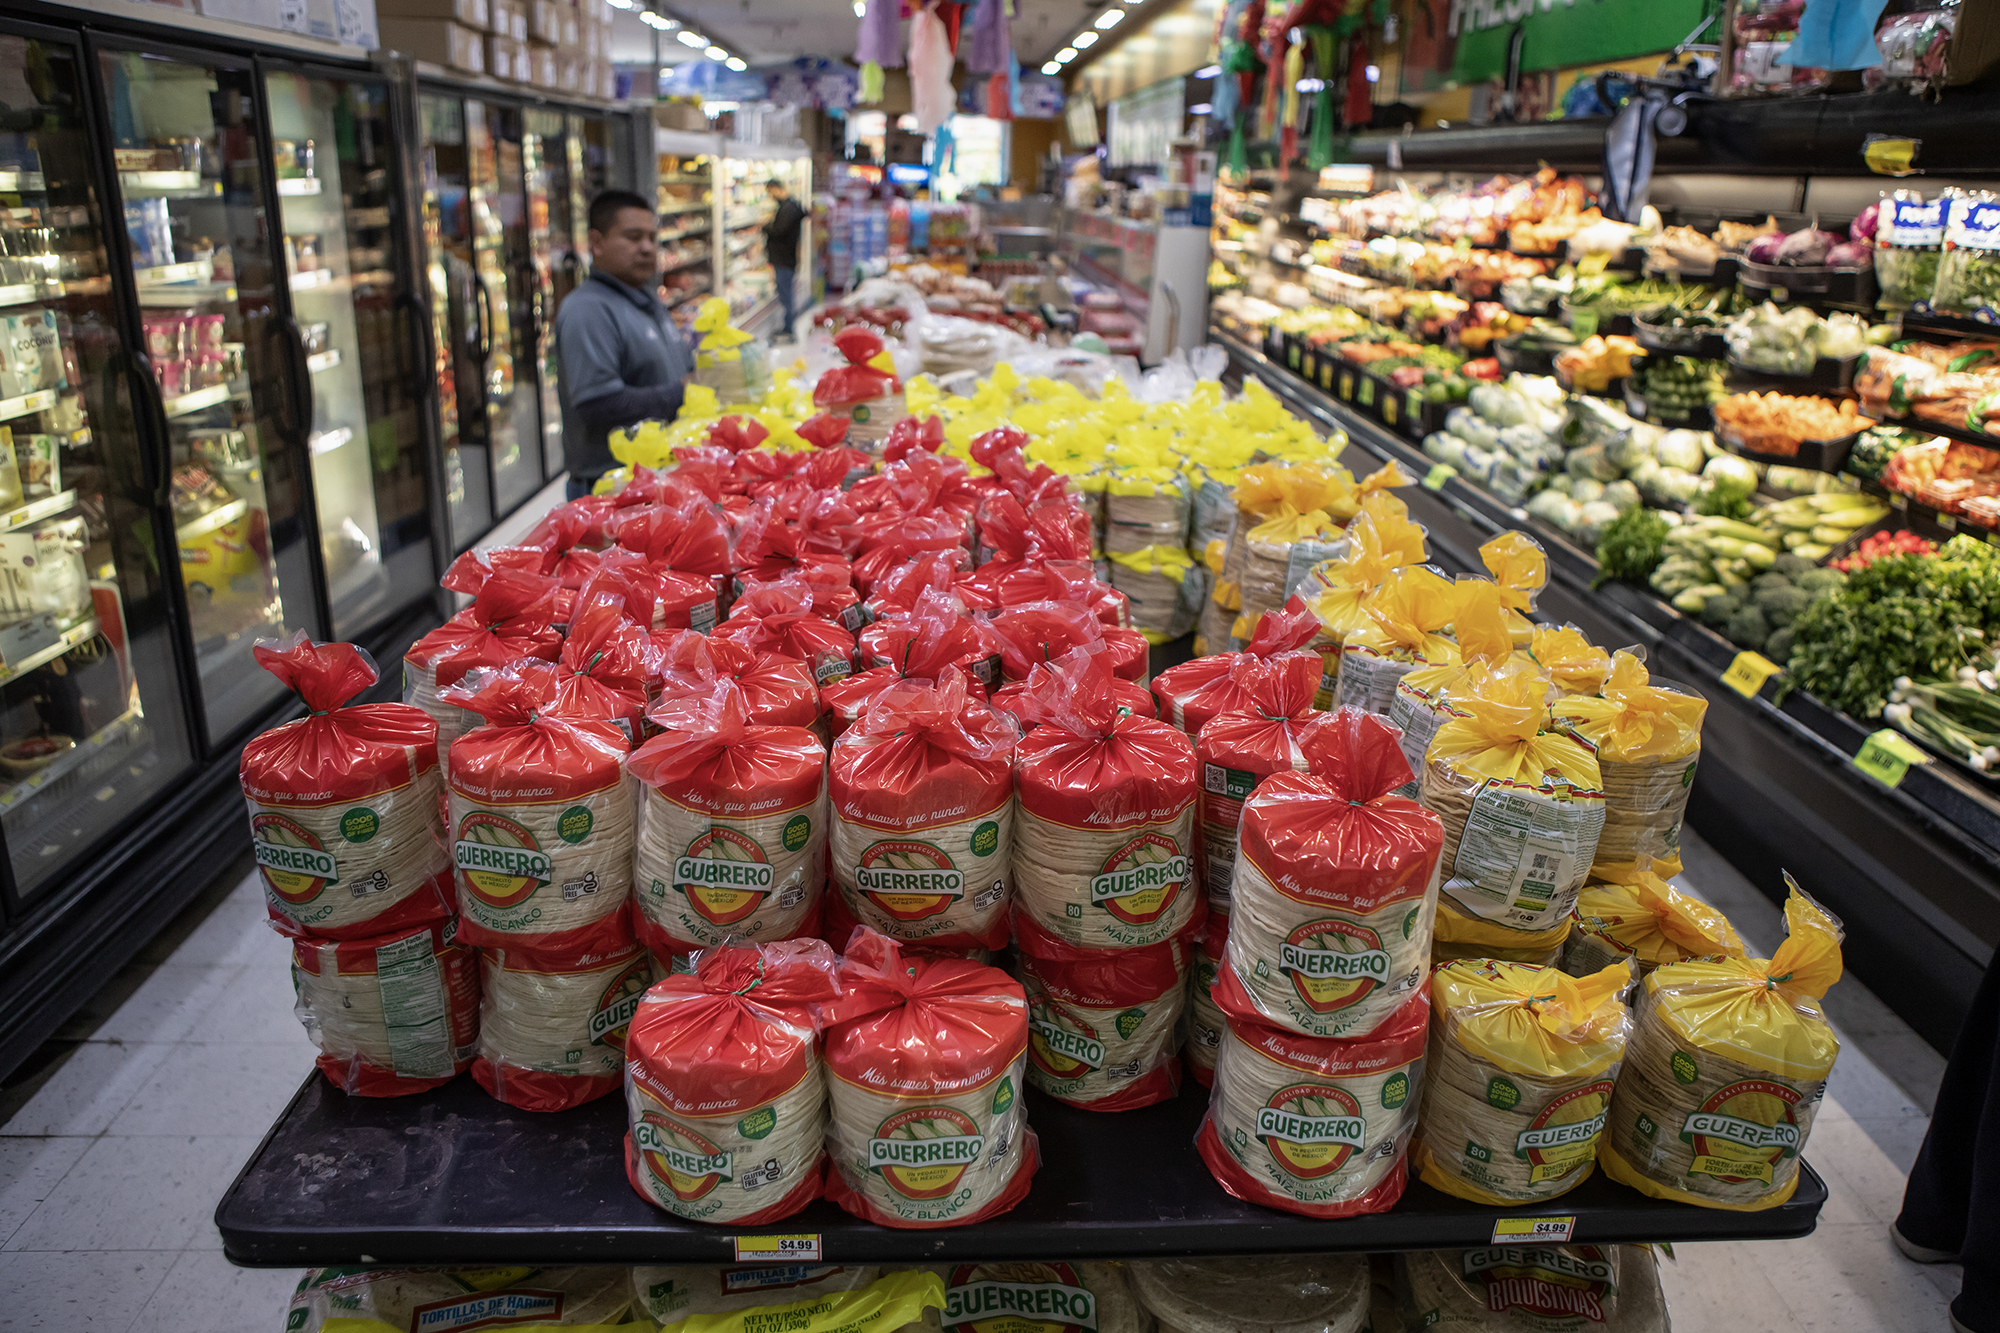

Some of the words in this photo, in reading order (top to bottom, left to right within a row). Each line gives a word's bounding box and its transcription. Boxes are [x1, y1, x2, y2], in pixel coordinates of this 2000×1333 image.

[17, 334, 57, 350] COCONUT
[274, 792, 293, 802] que
[297, 790, 334, 800] nunca
[491, 788, 512, 801] que
[516, 787, 554, 797] nunca
[725, 800, 746, 813] que
[749, 797, 783, 810] nunca
[345, 814, 373, 826] GOOD
[563, 814, 589, 826] GOOD
[844, 802, 863, 818] Más
[866, 814, 902, 826] suaves
[906, 813, 927, 828] que
[931, 805, 966, 820] nunca
[1083, 811, 1112, 824] Más
[1151, 807, 1171, 819] que
[346, 821, 375, 831] SOURCE
[488, 818, 525, 839] FRESCURA
[563, 821, 589, 831] SOURCE
[786, 822, 808, 834] GOOD
[786, 829, 807, 839] SOURCE
[720, 831, 754, 852] FRESCURA
[255, 841, 332, 873] GUERRERO
[456, 845, 546, 872] GUERRERO
[868, 844, 894, 859] CALIDAD
[903, 845, 940, 860] FRESCURA
[1113, 841, 1141, 863] CALIDAD
[353, 880, 375, 888] GLUTEN
[857, 870, 960, 890] GUERRERO
[1095, 860, 1185, 895] GUERRERO
[565, 882, 584, 891] GLUTEN
[654, 882, 663, 895] 80
[1277, 873, 1302, 892] Más
[1305, 887, 1350, 901] suaves
[1354, 895, 1375, 908] que
[976, 891, 993, 902] GLUTEN
[492, 908, 542, 930] BLANCO
[1068, 905, 1080, 917] 80
[679, 913, 708, 941] MAÍZ
[905, 920, 955, 938] BLANCO
[1103, 925, 1135, 945] MAÍZ
[1298, 924, 1331, 937] CALIDAD
[575, 954, 602, 966] Más
[1283, 947, 1386, 974] GUERRERO
[1081, 996, 1115, 1005] nunca
[1262, 1037, 1286, 1056] Más
[1288, 1051, 1328, 1068] suaves
[1331, 1059, 1353, 1073] que
[1674, 1055, 1695, 1072] GOOD
[628, 1059, 647, 1080] Más
[648, 1075, 674, 1102] suaves
[675, 1098, 694, 1111] que
[698, 1099, 739, 1110] nunca
[858, 1066, 888, 1085] Más
[934, 1080, 959, 1093] que
[960, 1066, 993, 1087] nunca
[1385, 1079, 1405, 1092] GOOD
[1386, 1087, 1406, 1098] SOURCE
[1491, 1089, 1517, 1099] SOURCE
[1493, 1082, 1517, 1095] GOOD
[1719, 1084, 1762, 1100] CALIDAD
[1280, 1088, 1311, 1100] CALIDAD
[1321, 1089, 1352, 1107] FRESCURA
[1546, 1090, 1582, 1115] CALIDAD
[744, 1114, 771, 1131] SOURCE
[887, 1112, 917, 1129] CALIDAD
[928, 1111, 965, 1126] FRESCURA
[1260, 1111, 1362, 1139] GUERRERO
[1639, 1119, 1652, 1133] 80
[669, 1123, 706, 1148] FRESCURA
[746, 1127, 754, 1135] OF
[755, 1122, 773, 1133] FIBER
[1236, 1130, 1246, 1145] 80
[872, 1139, 982, 1164] GUERRERO
[1471, 1147, 1486, 1159] 80
[743, 1170, 766, 1181] GLUTEN
[1704, 1165, 1728, 1174] ESTILO
[745, 1178, 758, 1187] FREE
[1265, 1163, 1296, 1192] MAÍZ
[1295, 1176, 1347, 1201] BLANCO
[672, 1200, 723, 1218] BLANCO
[918, 1188, 972, 1220] BLANCO
[1536, 1223, 1566, 1232] $4.99
[781, 1240, 812, 1249] $4.99
[1470, 1250, 1609, 1278] GUERRERO
[728, 1269, 785, 1283] TORTILLAS
[945, 1286, 1091, 1319] GUERRERO
[1489, 1278, 1603, 1321] RIQUISIMAS
[422, 1302, 485, 1325] TORTILLAS
[489, 1298, 504, 1310] DE
[507, 1297, 554, 1309] HARINA
[744, 1316, 764, 1325] NET
[808, 1302, 833, 1316] NETO
[454, 1315, 478, 1325] FLOUR
[769, 1322, 783, 1332] OZ
[785, 1319, 810, 1331] (330g)
[1425, 1313, 1437, 1326] 24
